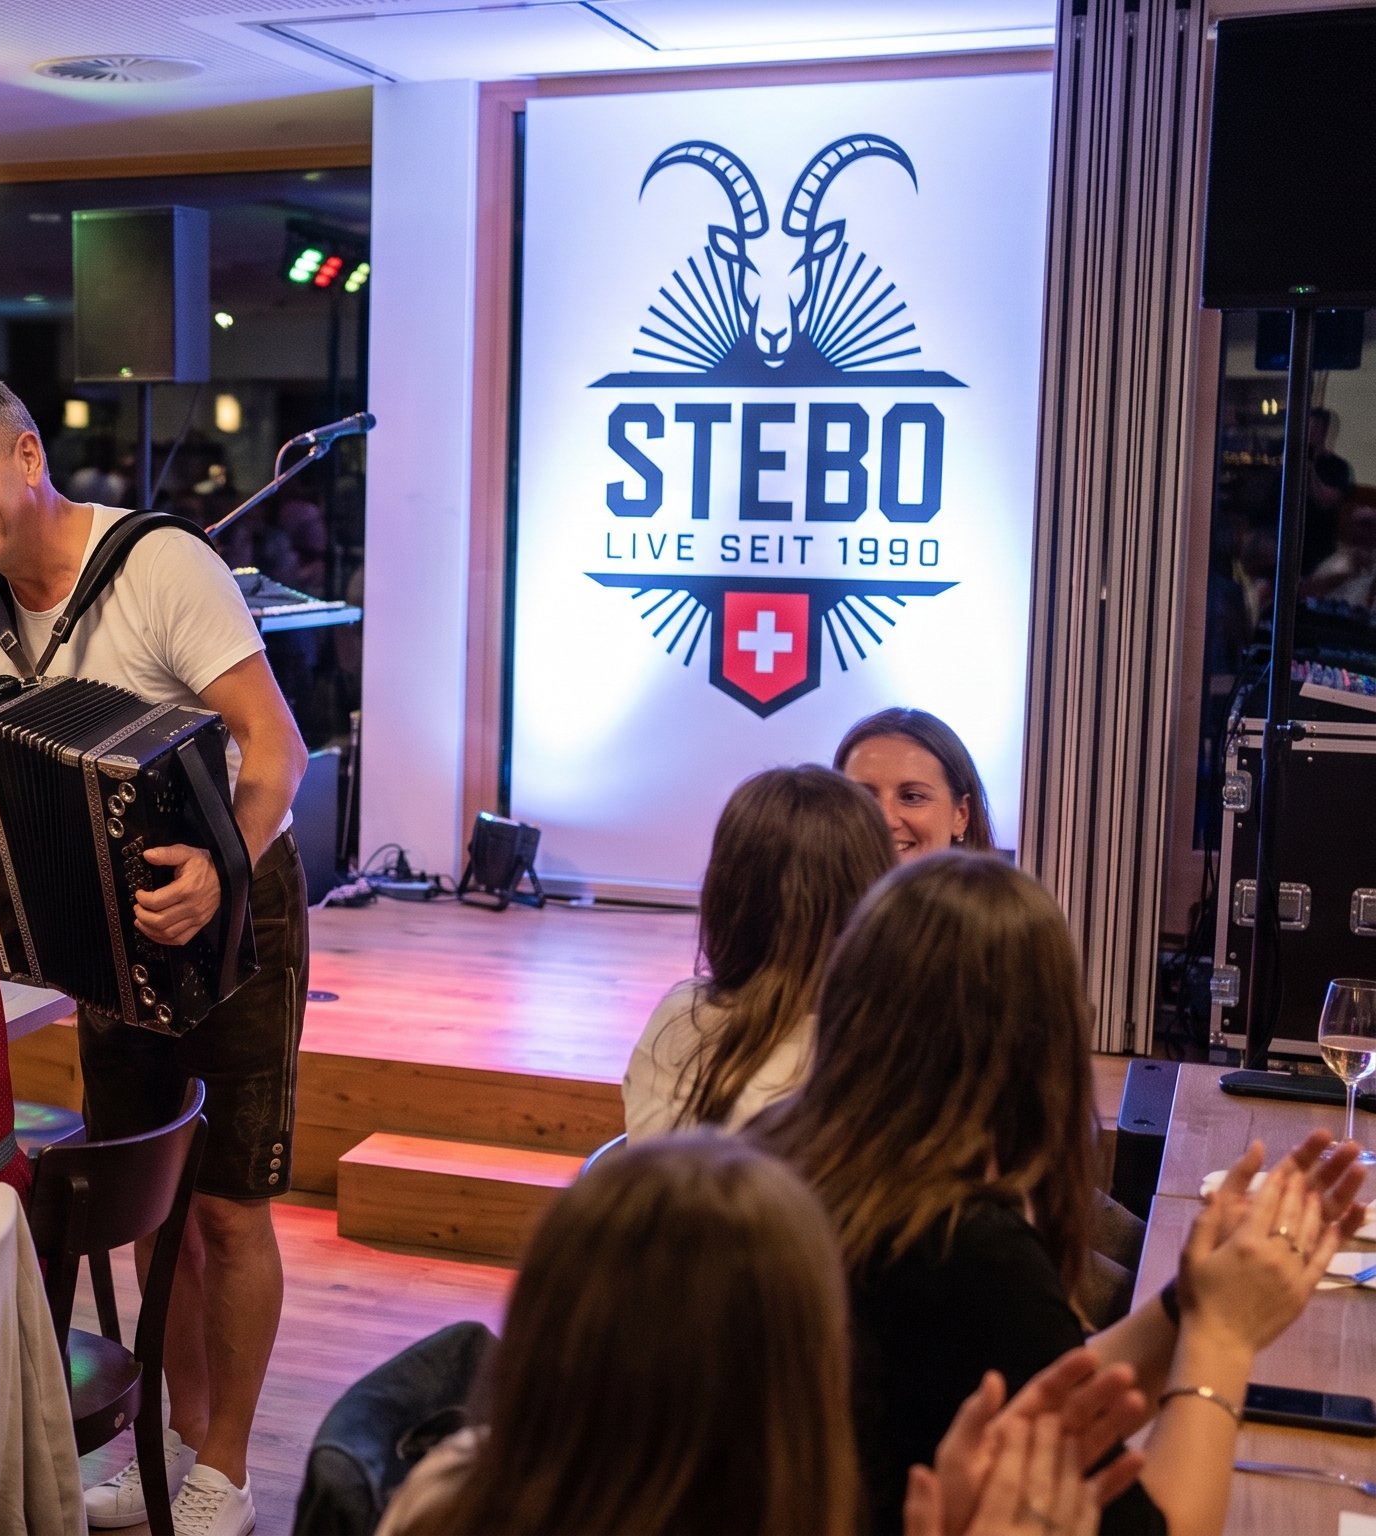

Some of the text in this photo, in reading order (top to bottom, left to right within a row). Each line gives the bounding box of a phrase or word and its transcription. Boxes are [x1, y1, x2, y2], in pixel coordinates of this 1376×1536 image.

[605, 402, 945, 523] STEBO
[606, 532, 939, 567] LIVE SEIT 1990
